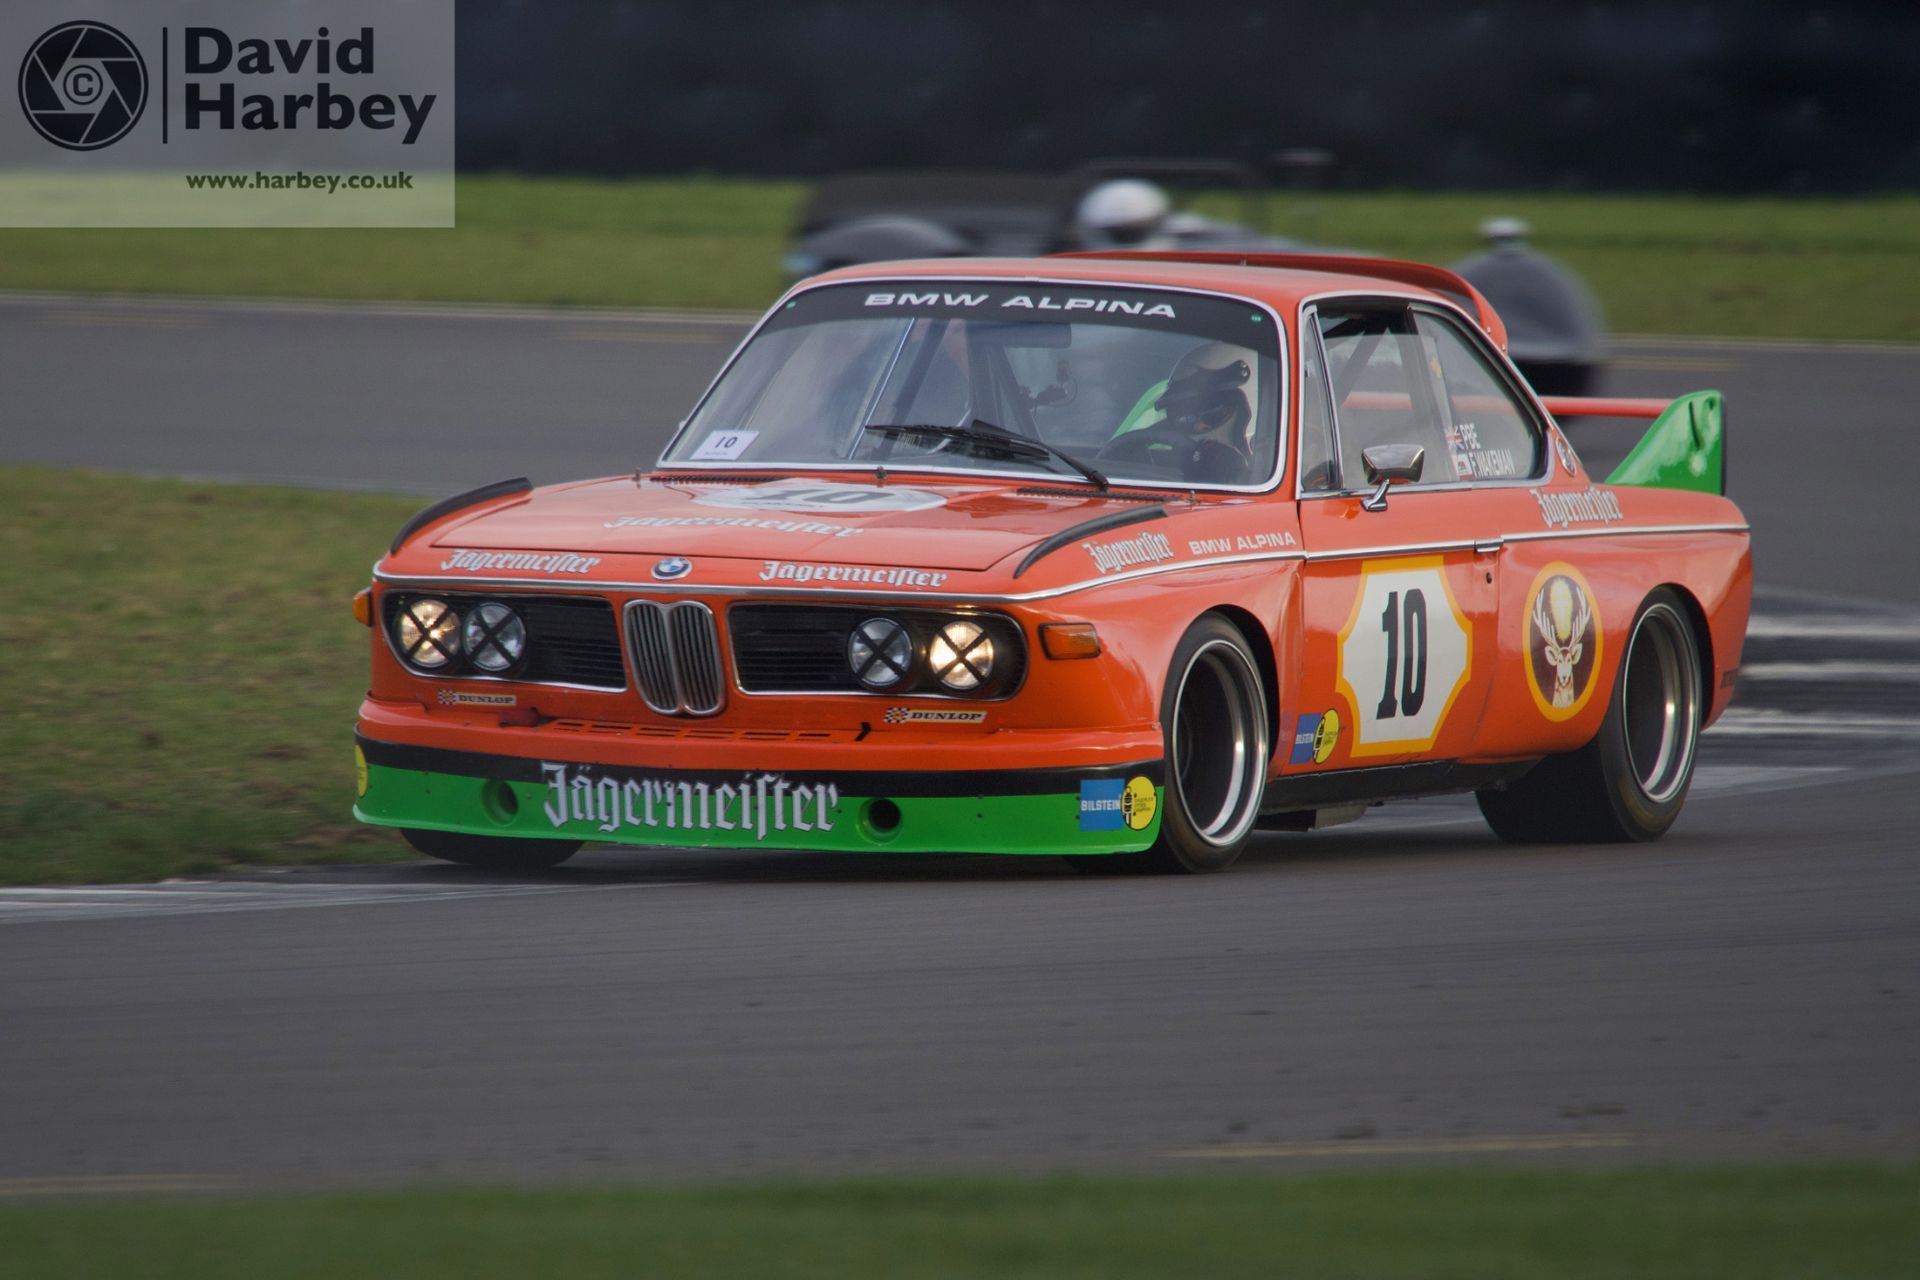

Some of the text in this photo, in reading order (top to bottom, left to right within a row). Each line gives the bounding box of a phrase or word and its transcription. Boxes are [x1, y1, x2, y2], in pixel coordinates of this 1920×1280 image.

[864, 293, 1176, 318] BMW ALPINA
[714, 436, 738, 449] 10
[743, 488, 894, 504] 10
[1188, 530, 1297, 556] BMW ALPINA
[441, 548, 601, 574] Jägermeister
[759, 560, 948, 587] Jägermeister
[1376, 588, 1427, 720] 10
[458, 694, 514, 704] DUNLOP
[911, 711, 982, 721] DUNLOP
[541, 760, 838, 841] Jägermeister
[1080, 800, 1121, 811] BILSTEIN
